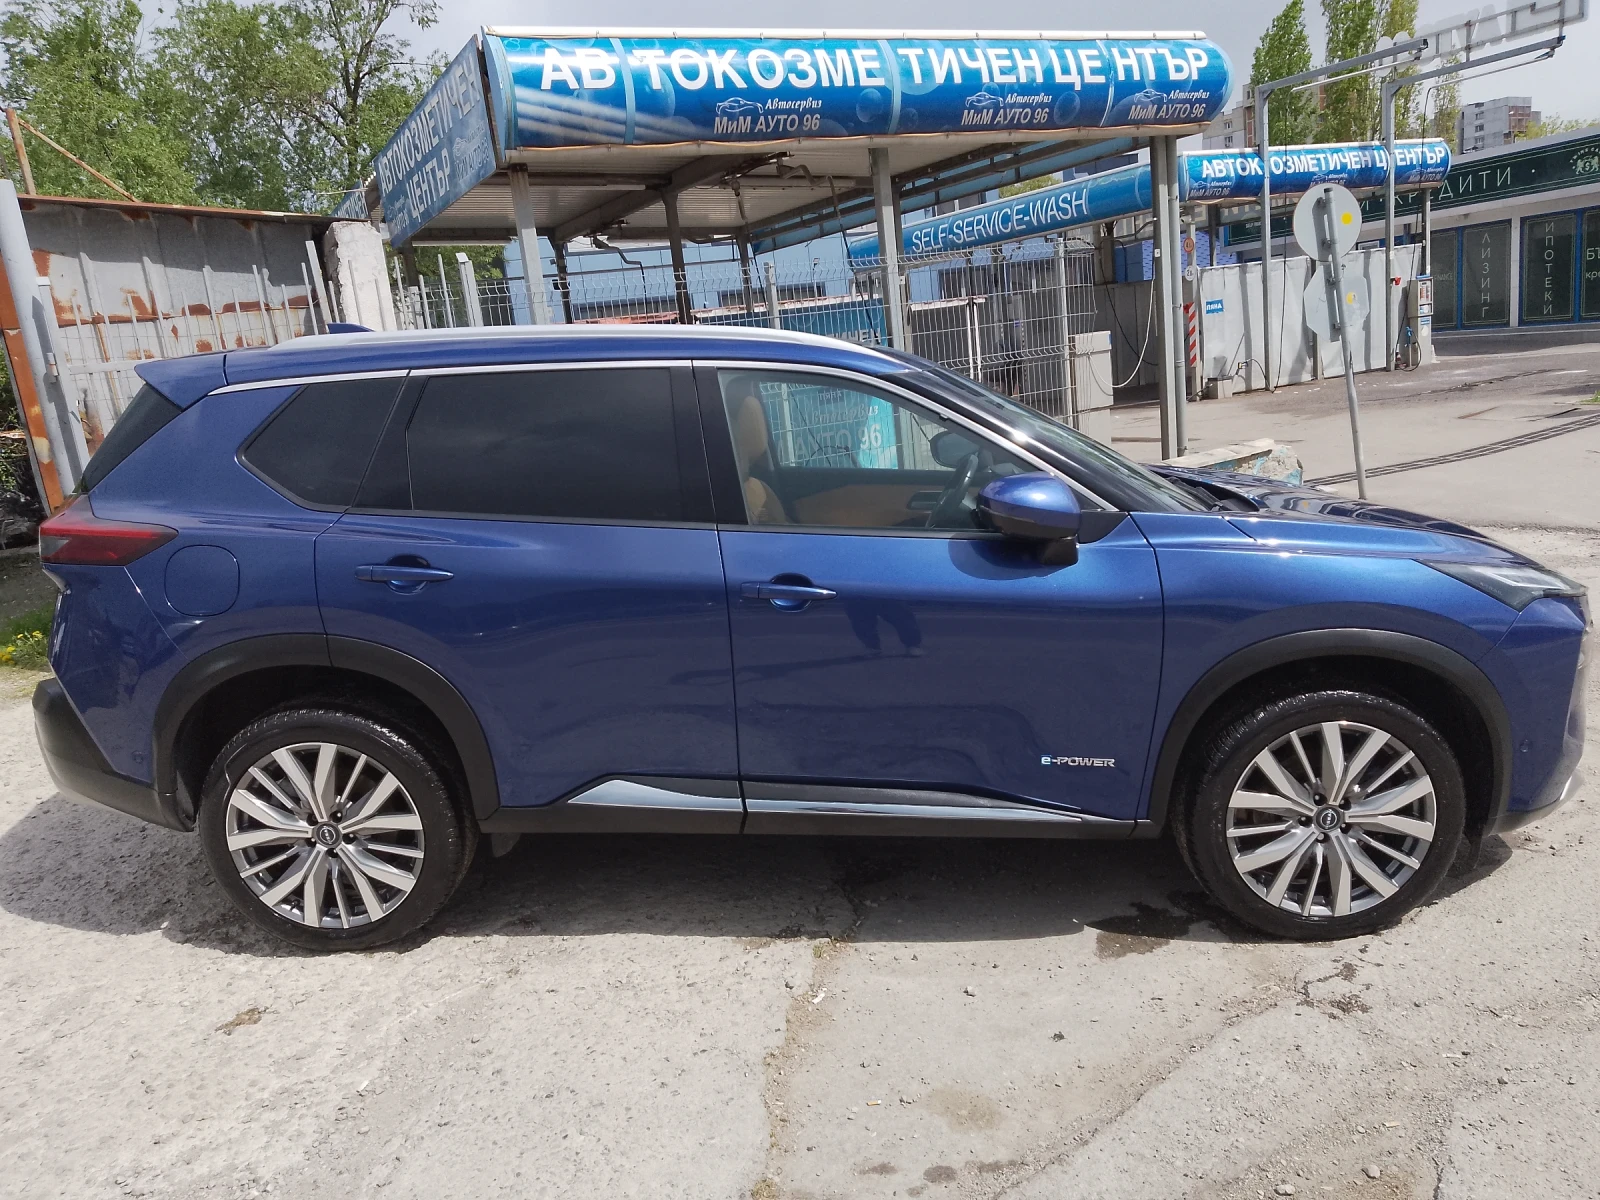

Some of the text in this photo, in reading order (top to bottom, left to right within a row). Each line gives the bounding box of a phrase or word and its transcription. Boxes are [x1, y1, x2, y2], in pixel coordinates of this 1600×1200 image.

[764, 97, 822, 112] Автосервиз
[1005, 92, 1052, 106] Автосервиз
[1168, 89, 1210, 102] Автосервиз
[961, 107, 1049, 126] МиМ АУТО 96
[1128, 103, 1206, 120] МиМ АУТО 96
[378, 53, 481, 197] АВТОКОЗМЕТИЧЕН
[714, 113, 821, 134] МиМ АУТО 96
[406, 147, 450, 222] ЦЕНТЪР
[912, 188, 1088, 253] SELF-SERVICE-WASH
[1481, 232, 1491, 318] ЛИЗИНГ
[1543, 221, 1554, 315] ИПОТЕКИ
[1206, 303, 1223, 311] ПЯНА
[857, 423, 882, 450] 96
[1041, 756, 1116, 768] e-POWER
